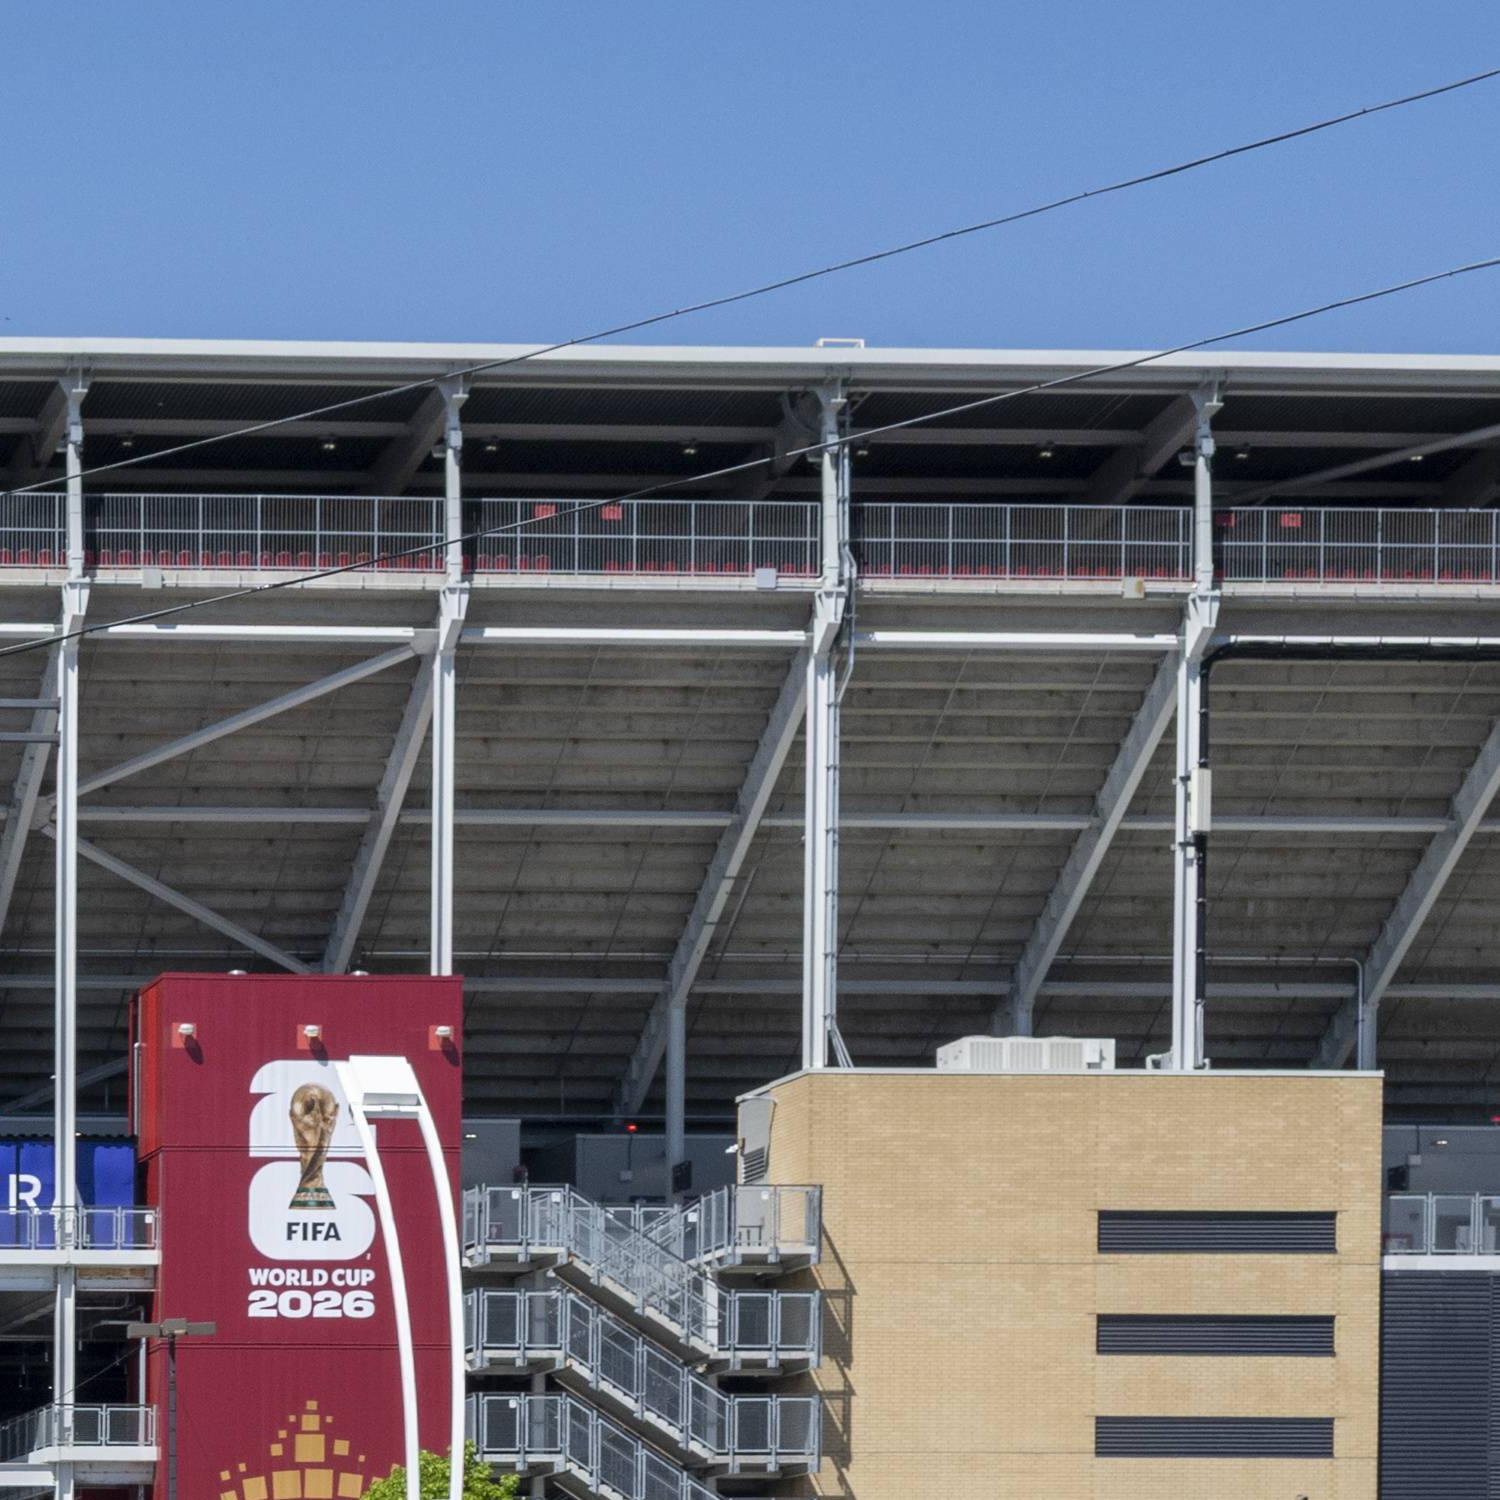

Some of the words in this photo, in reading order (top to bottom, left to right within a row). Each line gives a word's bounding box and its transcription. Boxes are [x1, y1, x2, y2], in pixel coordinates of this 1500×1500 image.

[286, 1222, 341, 1241] FIFA
[248, 1268, 328, 1287] WORLD
[331, 1268, 376, 1287] CUP
[248, 1290, 376, 1318] 2026
